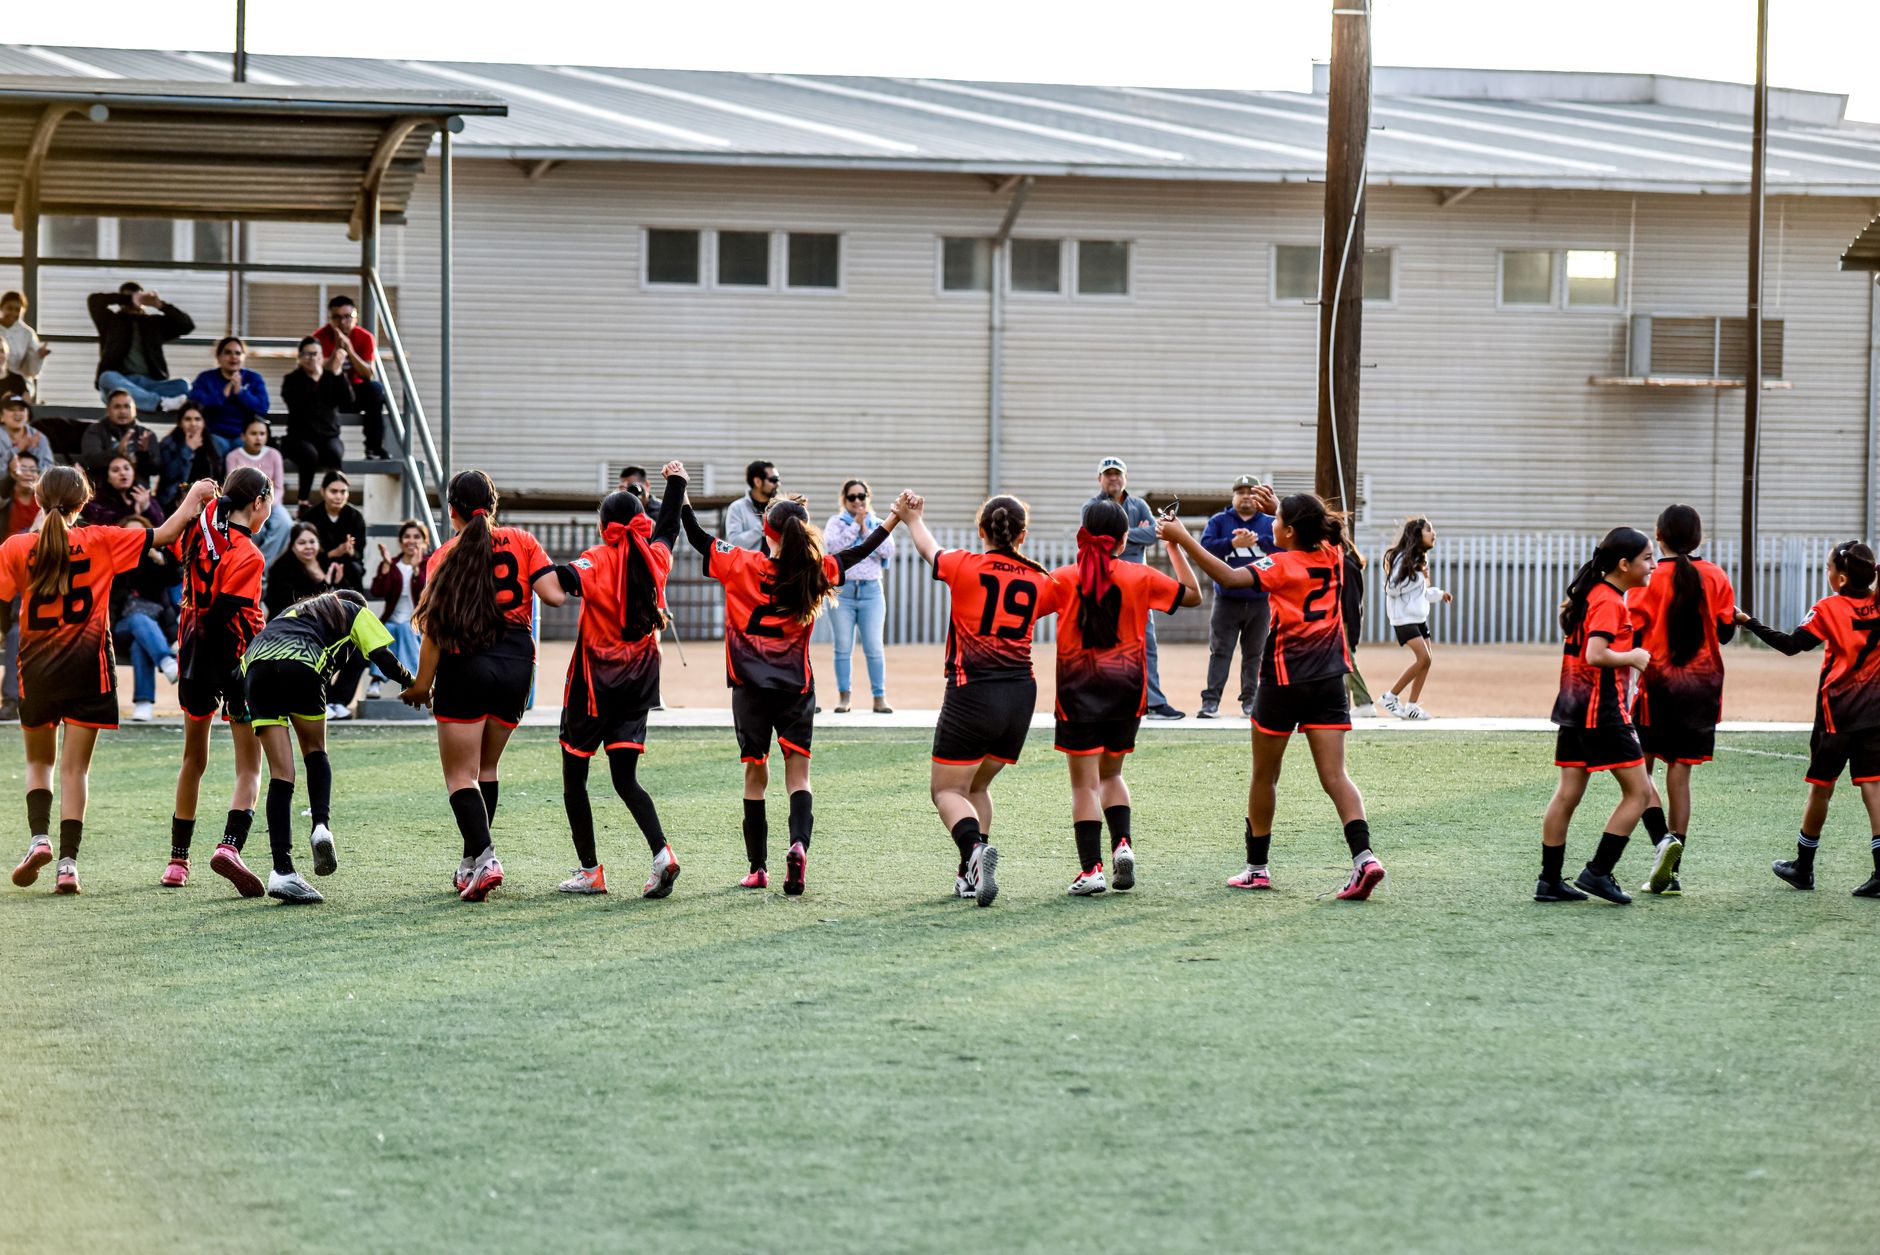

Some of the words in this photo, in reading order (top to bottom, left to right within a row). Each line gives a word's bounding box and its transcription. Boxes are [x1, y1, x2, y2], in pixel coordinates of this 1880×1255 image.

[992, 561, 1026, 575] ROMY
[1303, 563, 1342, 622] 21
[979, 573, 1038, 640] 19
